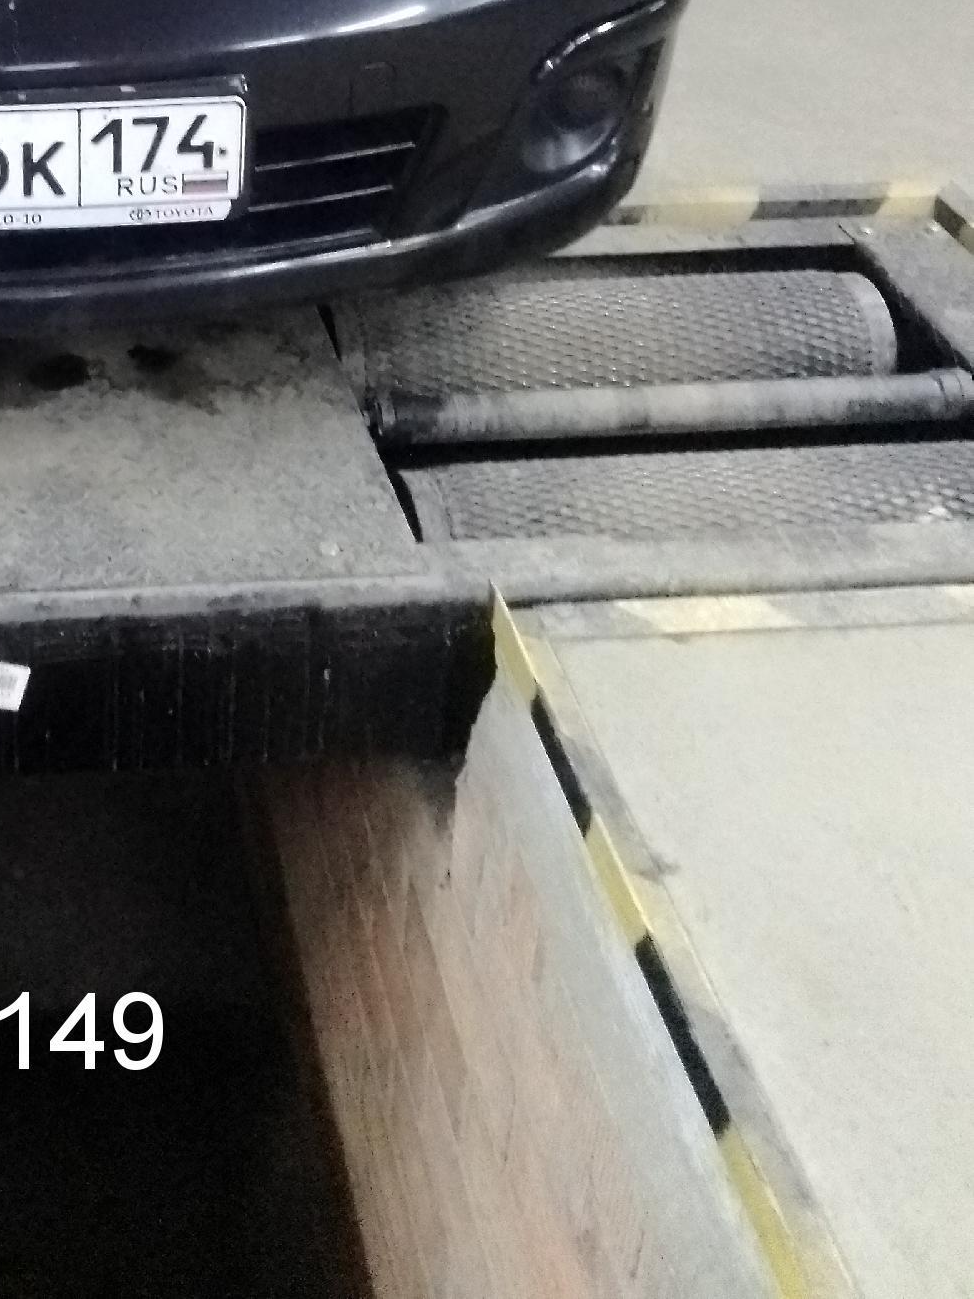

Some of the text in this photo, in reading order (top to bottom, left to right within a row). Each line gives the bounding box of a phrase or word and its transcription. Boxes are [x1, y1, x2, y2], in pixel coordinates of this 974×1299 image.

[90, 113, 215, 173] 174
[116, 175, 179, 197] RUS
[156, 206, 215, 220] TOYOTA
